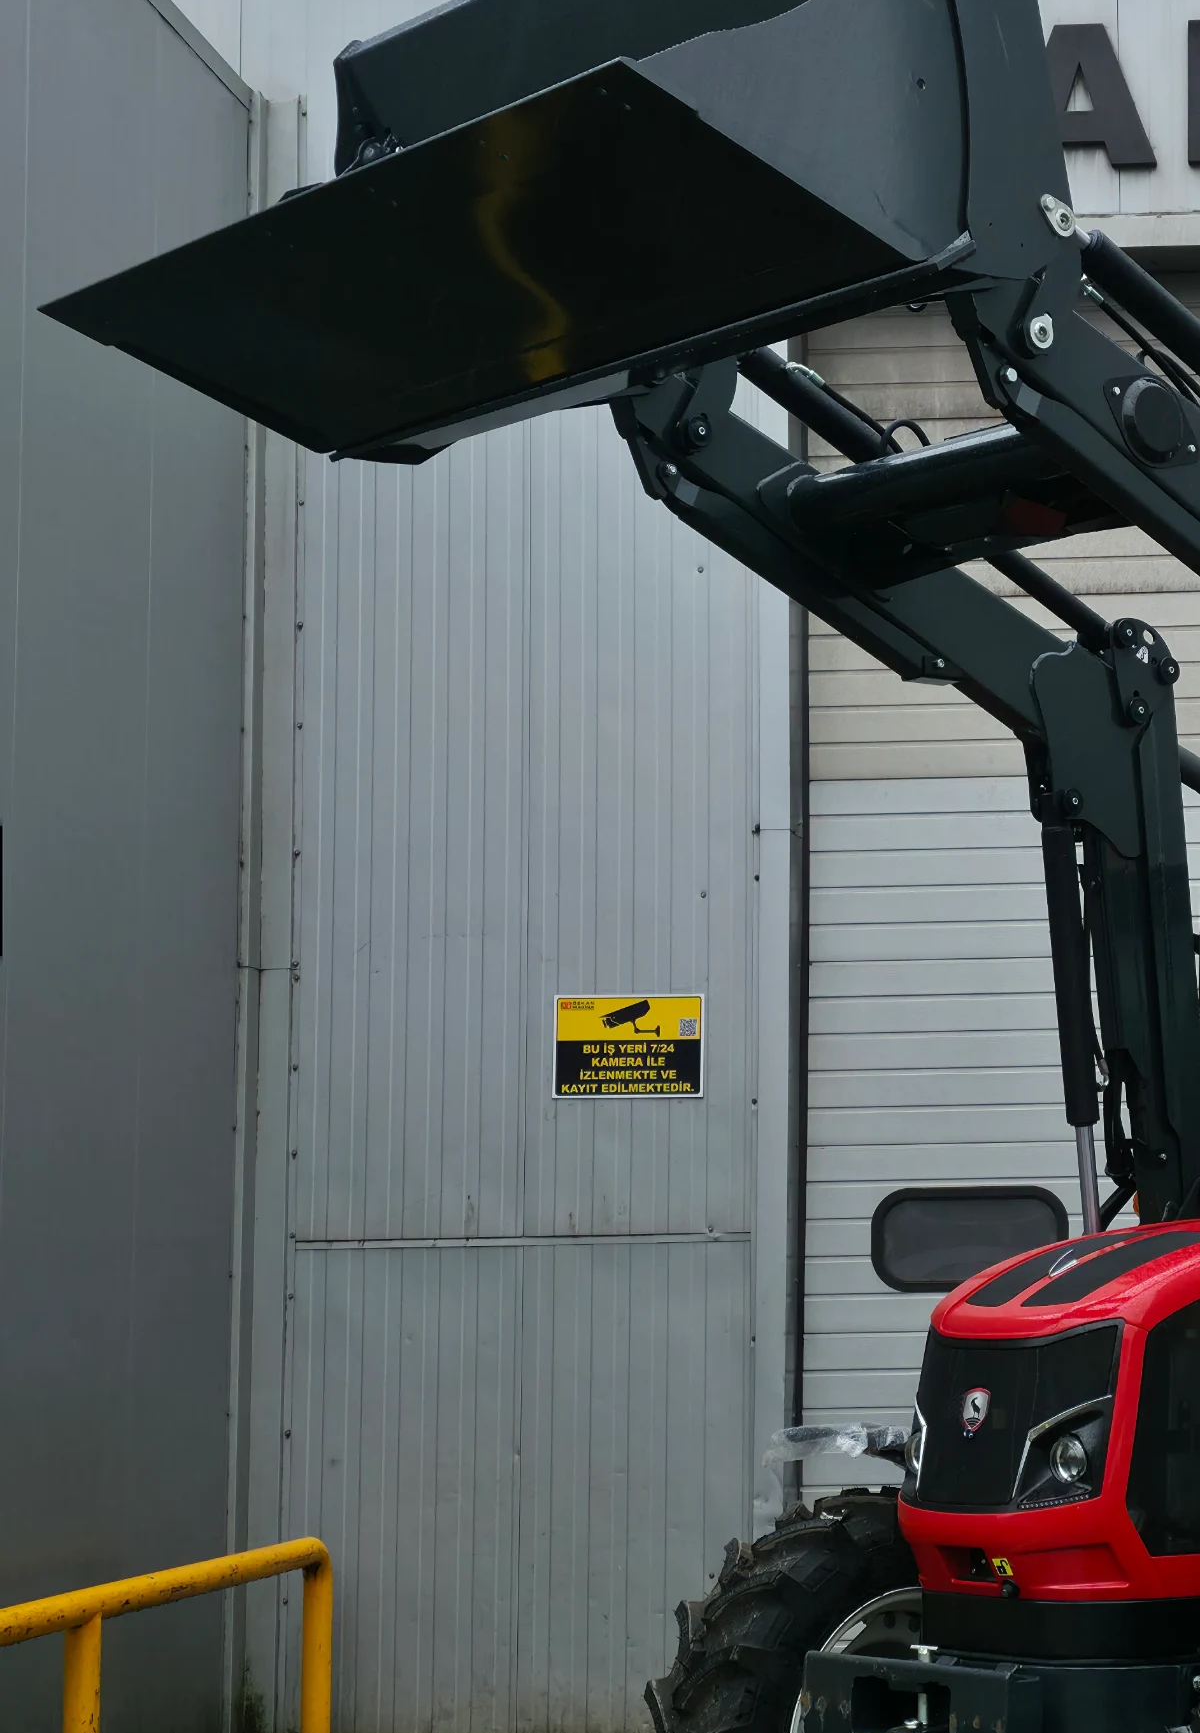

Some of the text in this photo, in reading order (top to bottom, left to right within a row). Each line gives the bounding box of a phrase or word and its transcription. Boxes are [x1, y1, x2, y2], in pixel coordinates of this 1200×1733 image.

[582, 1042, 675, 1056] BU İŞ YERİ 7/24
[591, 1056, 666, 1067] KAMERA İLE
[579, 1069, 677, 1081] İZLENMEKTE VE
[561, 1081, 695, 1094] KAYIT EDİLMEKTEDİR.
